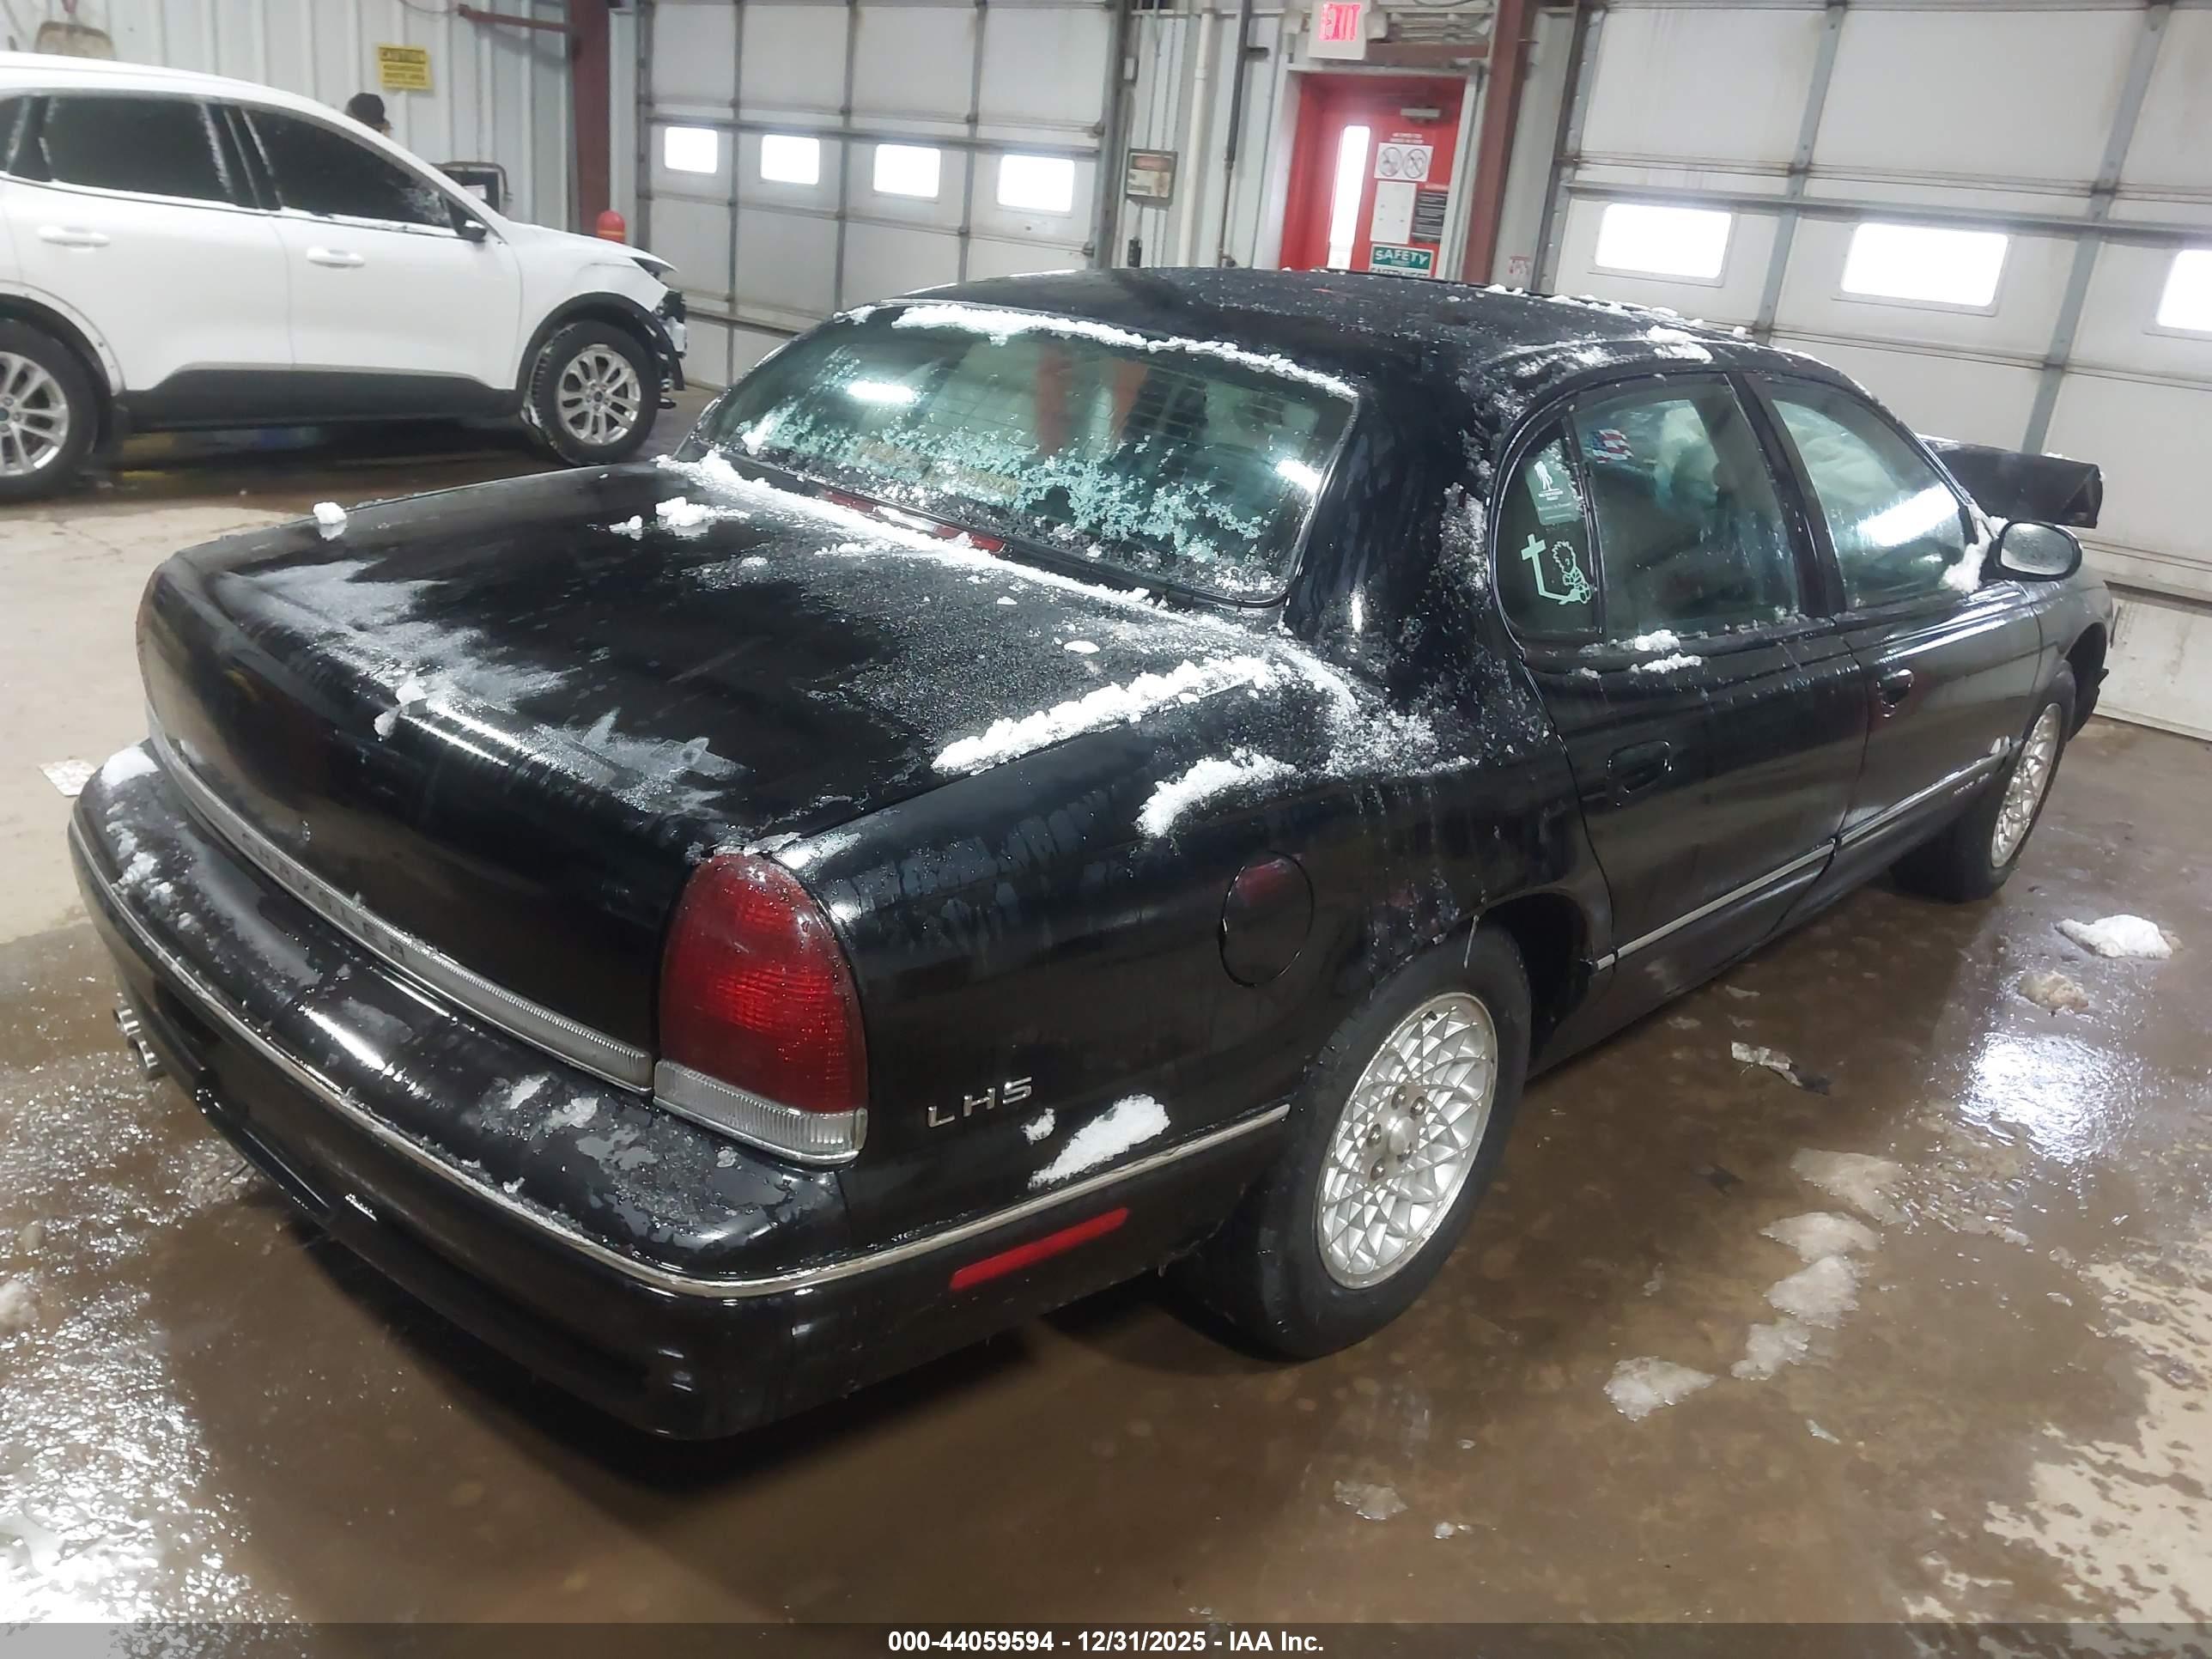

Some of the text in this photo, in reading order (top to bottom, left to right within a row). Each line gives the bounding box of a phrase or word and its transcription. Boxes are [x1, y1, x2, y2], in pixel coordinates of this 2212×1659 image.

[1319, 3, 1360, 41] EXIT
[1376, 249, 1429, 265] SAFETY
[928, 1077, 1032, 1127] LHS
